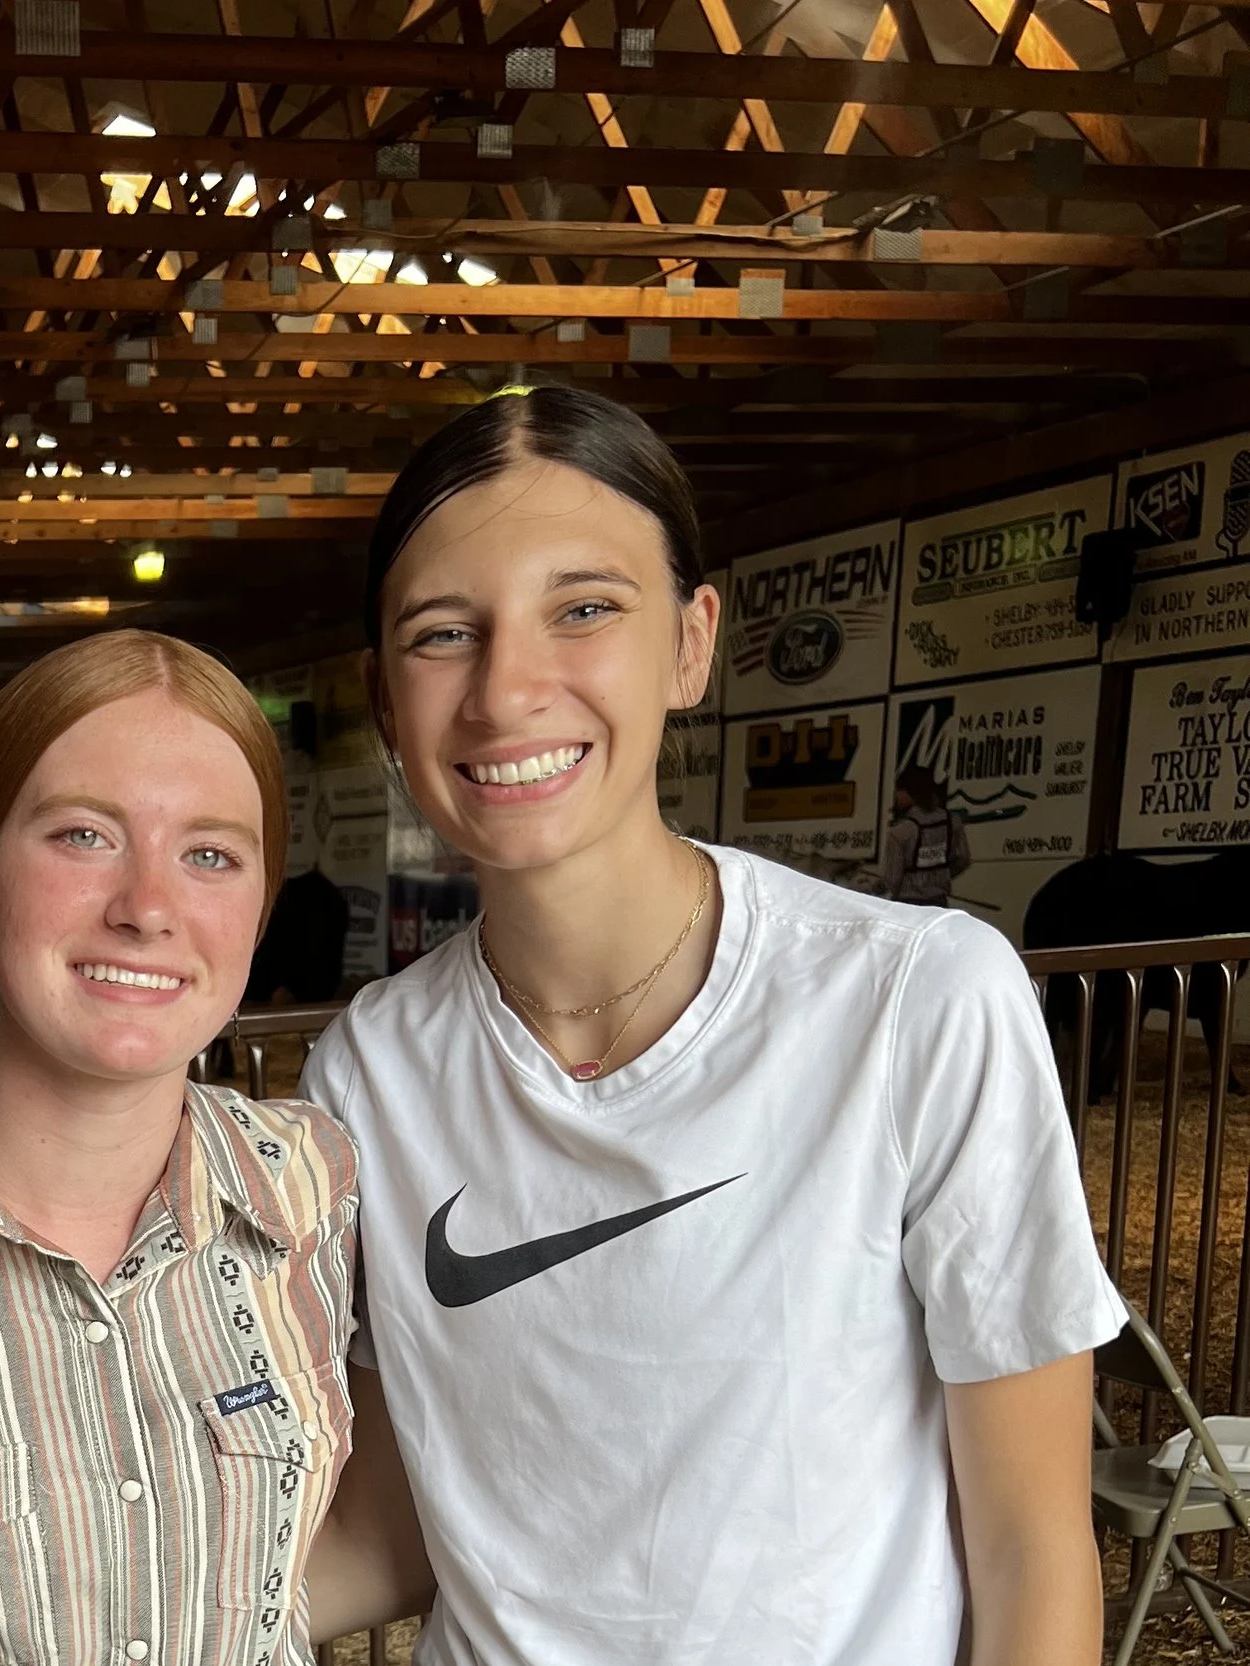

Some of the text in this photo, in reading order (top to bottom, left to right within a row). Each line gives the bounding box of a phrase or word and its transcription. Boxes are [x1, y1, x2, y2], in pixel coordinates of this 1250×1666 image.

[1130, 463, 1199, 537] KSEN
[917, 509, 1086, 583] SEUBERT
[732, 541, 895, 623] NORTHERN
[994, 603, 1039, 627] SHELBY
[1140, 591, 1195, 616] GLADLY
[991, 624, 1044, 649] CHESTER
[1134, 609, 1249, 645] IN NORTHERN
[958, 706, 1045, 733] MARIAS
[956, 734, 1042, 780] Healthcare
[1152, 747, 1221, 782] TRUE
[1139, 781, 1213, 815] FARM
[223, 1383, 268, 1408] Wrangler
